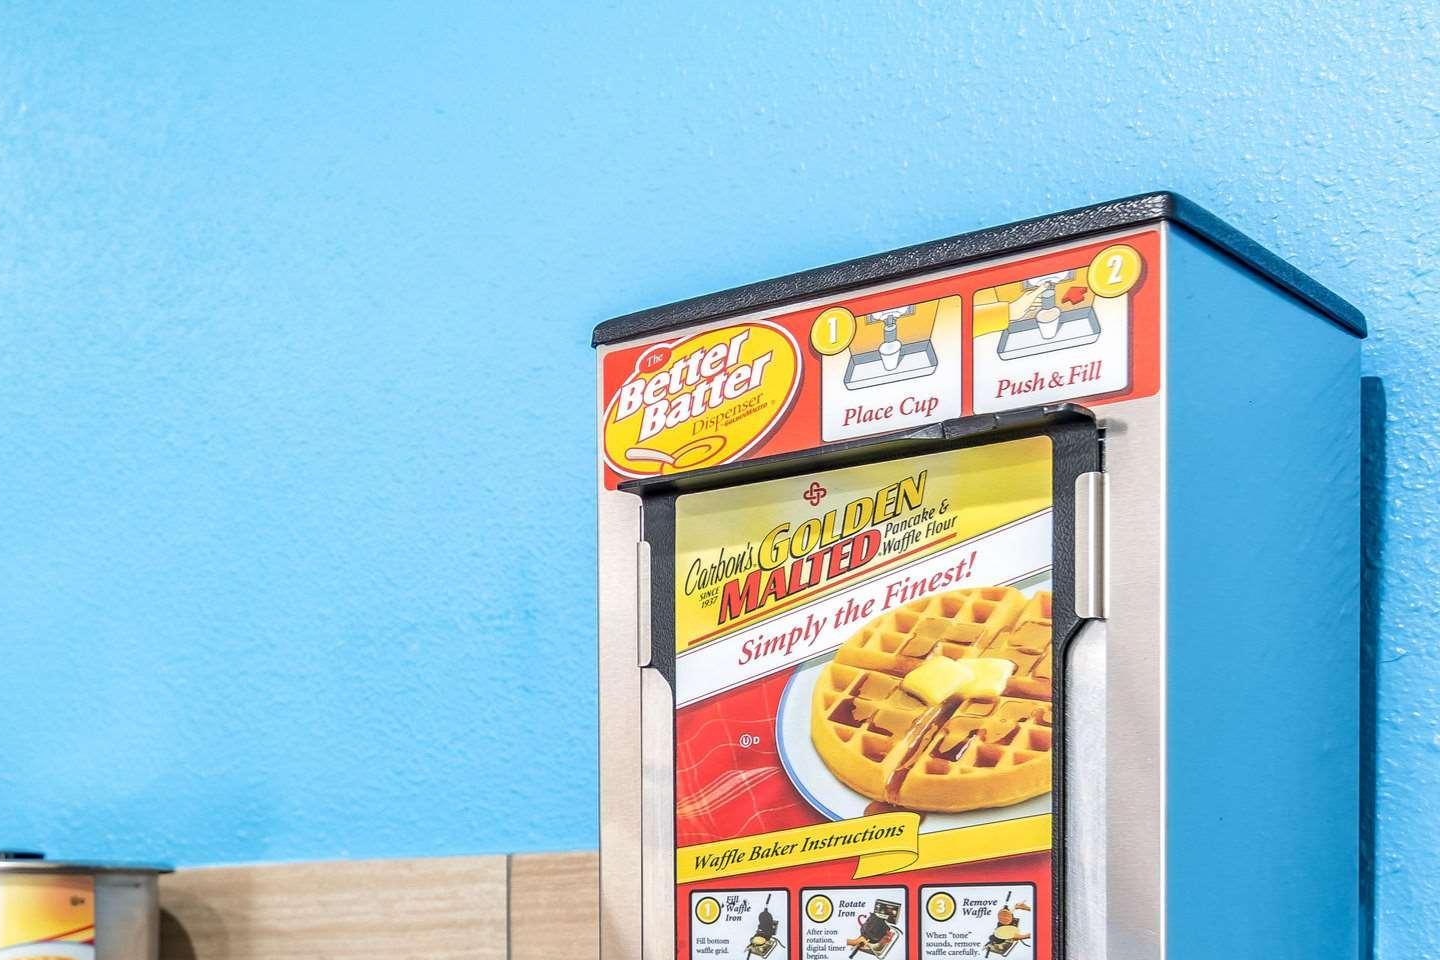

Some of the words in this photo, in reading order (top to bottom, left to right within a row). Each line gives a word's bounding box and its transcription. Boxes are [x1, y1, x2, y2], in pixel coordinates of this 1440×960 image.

[1108, 254, 1123, 281] 2
[827, 318, 839, 343] 1
[646, 353, 663, 367] The
[613, 328, 750, 424] Better
[996, 373, 1046, 398] Push
[1047, 369, 1064, 388] &
[1066, 361, 1103, 386] Fill
[636, 350, 773, 444] Batter
[692, 393, 763, 436] Dispenser
[843, 402, 895, 427] Place
[899, 394, 939, 420] Cup
[884, 507, 937, 539] Pancake
[939, 498, 950, 515] &
[684, 542, 754, 596] Carbon's
[757, 470, 928, 572] GOLDEN
[883, 530, 922, 556] Waffle
[925, 514, 958, 541] Flour
[717, 529, 881, 626] MALTED
[700, 587, 719, 601] SINCE
[738, 614, 827, 667] Simply
[833, 597, 873, 631] the
[880, 550, 977, 612] Finest!
[694, 845, 745, 871] Waffle
[748, 841, 798, 862] Baker
[800, 822, 905, 853] Instructions
[726, 903, 752, 915] Waffle
[838, 900, 867, 908] Rotate
[962, 898, 999, 907] Remove
[725, 914, 743, 922] Iron
[837, 909, 856, 918] Iron
[962, 907, 992, 919] Waffle
[806, 928, 823, 936] After
[925, 931, 947, 939] When
[696, 937, 706, 945] Fill
[707, 937, 730, 945] bottom
[925, 940, 953, 948] sounds,
[806, 945, 827, 954] digital
[925, 948, 946, 956] waffle
[947, 948, 981, 958] carefully.
